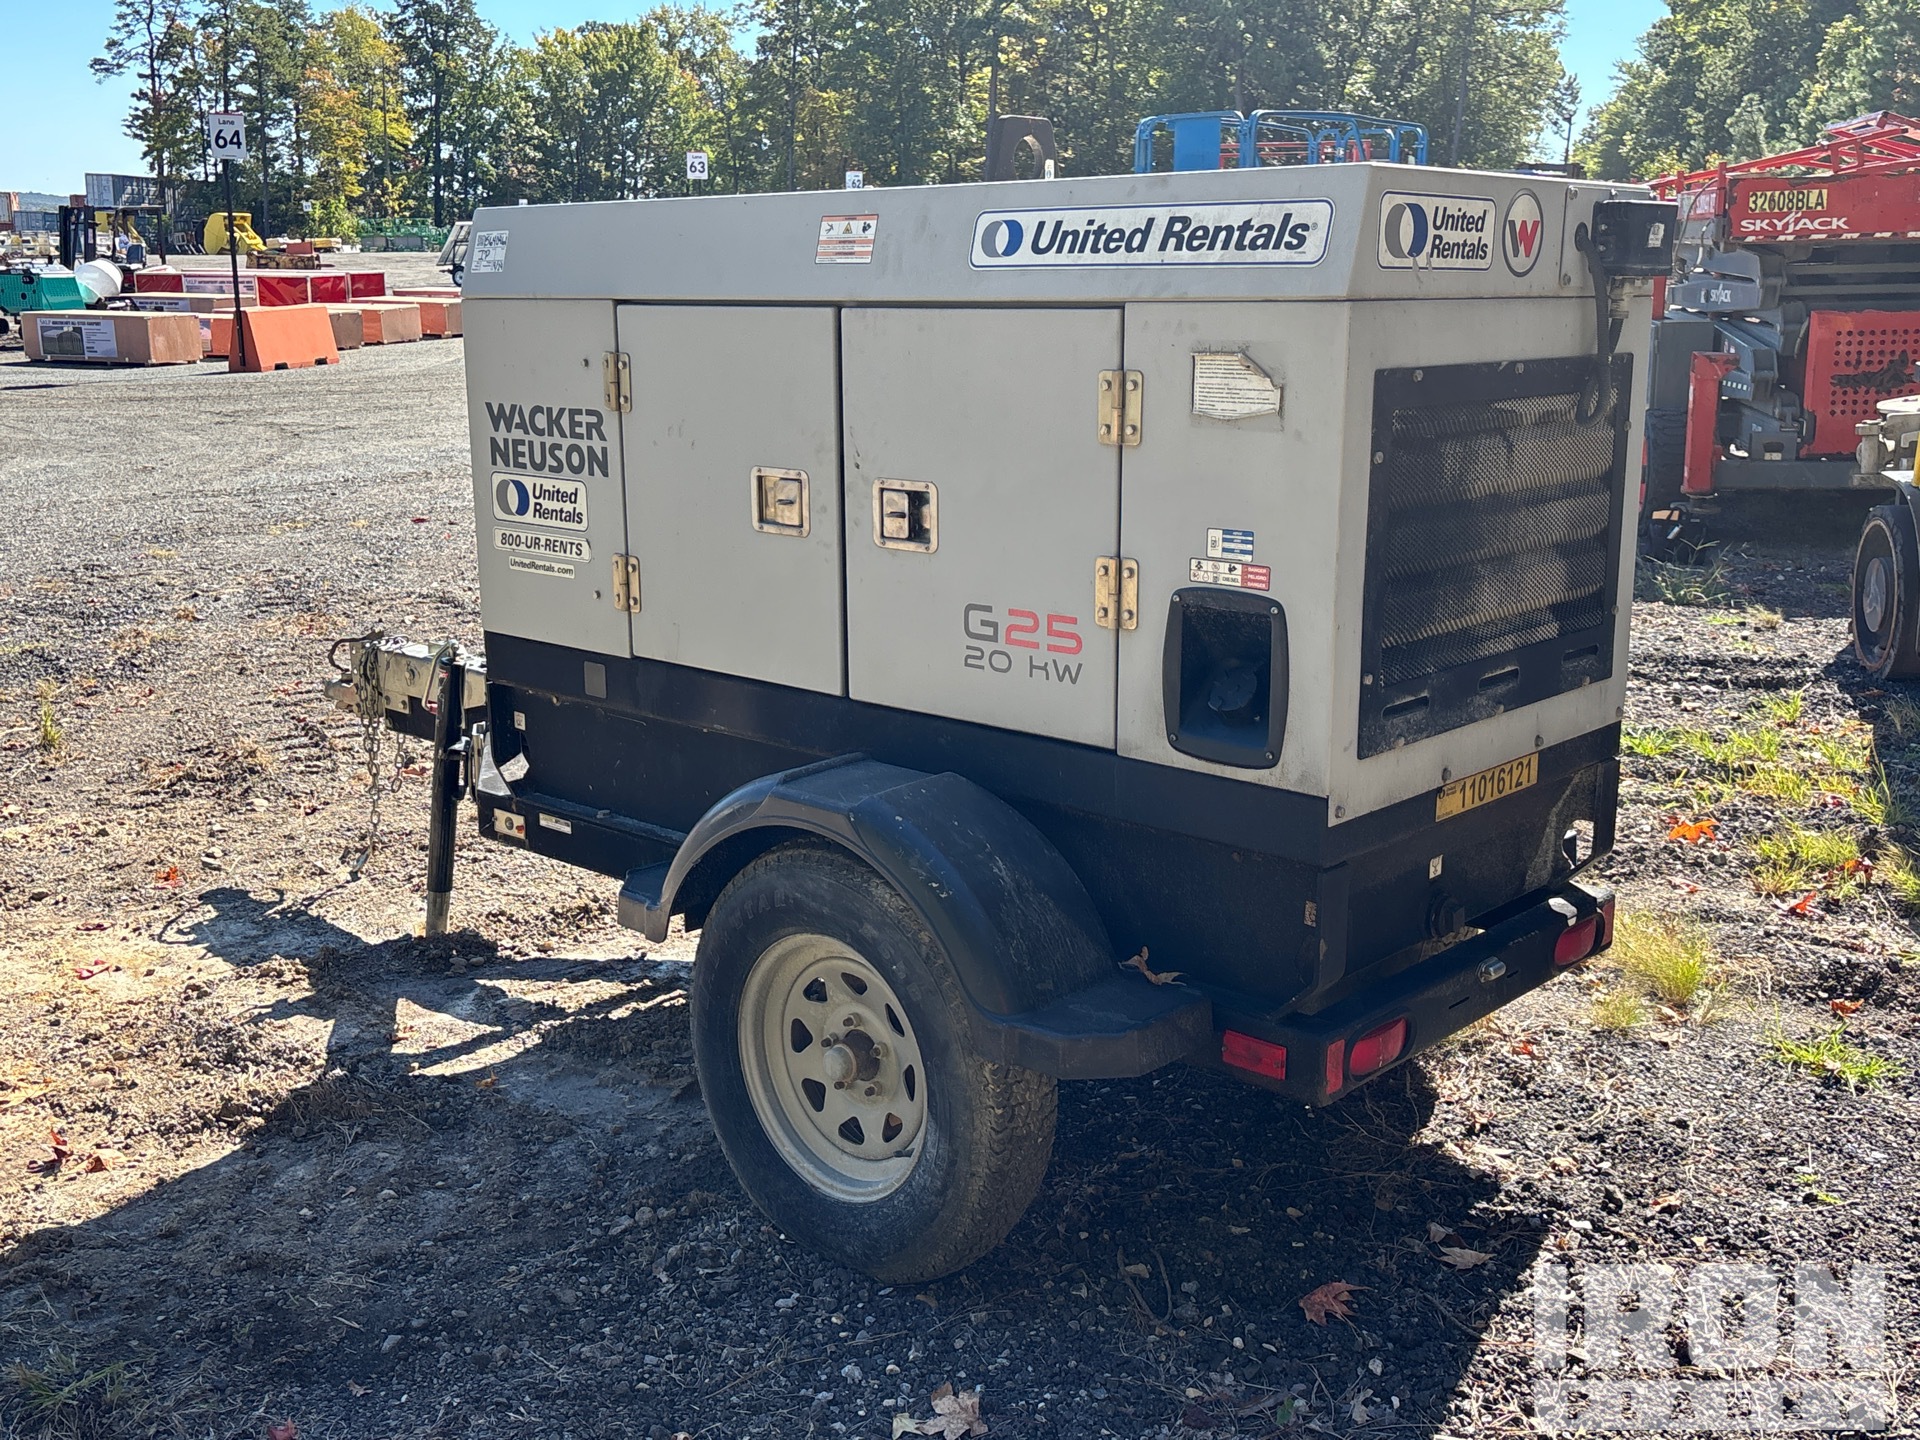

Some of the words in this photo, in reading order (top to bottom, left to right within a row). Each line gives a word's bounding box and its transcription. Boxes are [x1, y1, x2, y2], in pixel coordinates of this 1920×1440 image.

[218, 118, 235, 126] Lane
[215, 129, 242, 149] 64
[689, 161, 706, 174] 63
[851, 179, 861, 189] 62
[1748, 189, 1825, 213] 32608BLA
[1432, 206, 1487, 233] United
[1030, 216, 1156, 254] United
[1430, 234, 1489, 260] Rentals
[1508, 220, 1540, 257] W
[485, 401, 608, 442] WACKER
[489, 436, 609, 478] NEUSON
[532, 482, 579, 505] United
[532, 502, 584, 525] Rentals
[500, 532, 583, 557] 800-UR-RENTS
[510, 557, 575, 577] UnitedRentals.com
[1247, 566, 1267, 574] DANGER
[1222, 575, 1240, 584] DIESEL
[964, 602, 1083, 655] G25
[964, 645, 1013, 673] 20
[1459, 757, 1533, 808] 11016121
